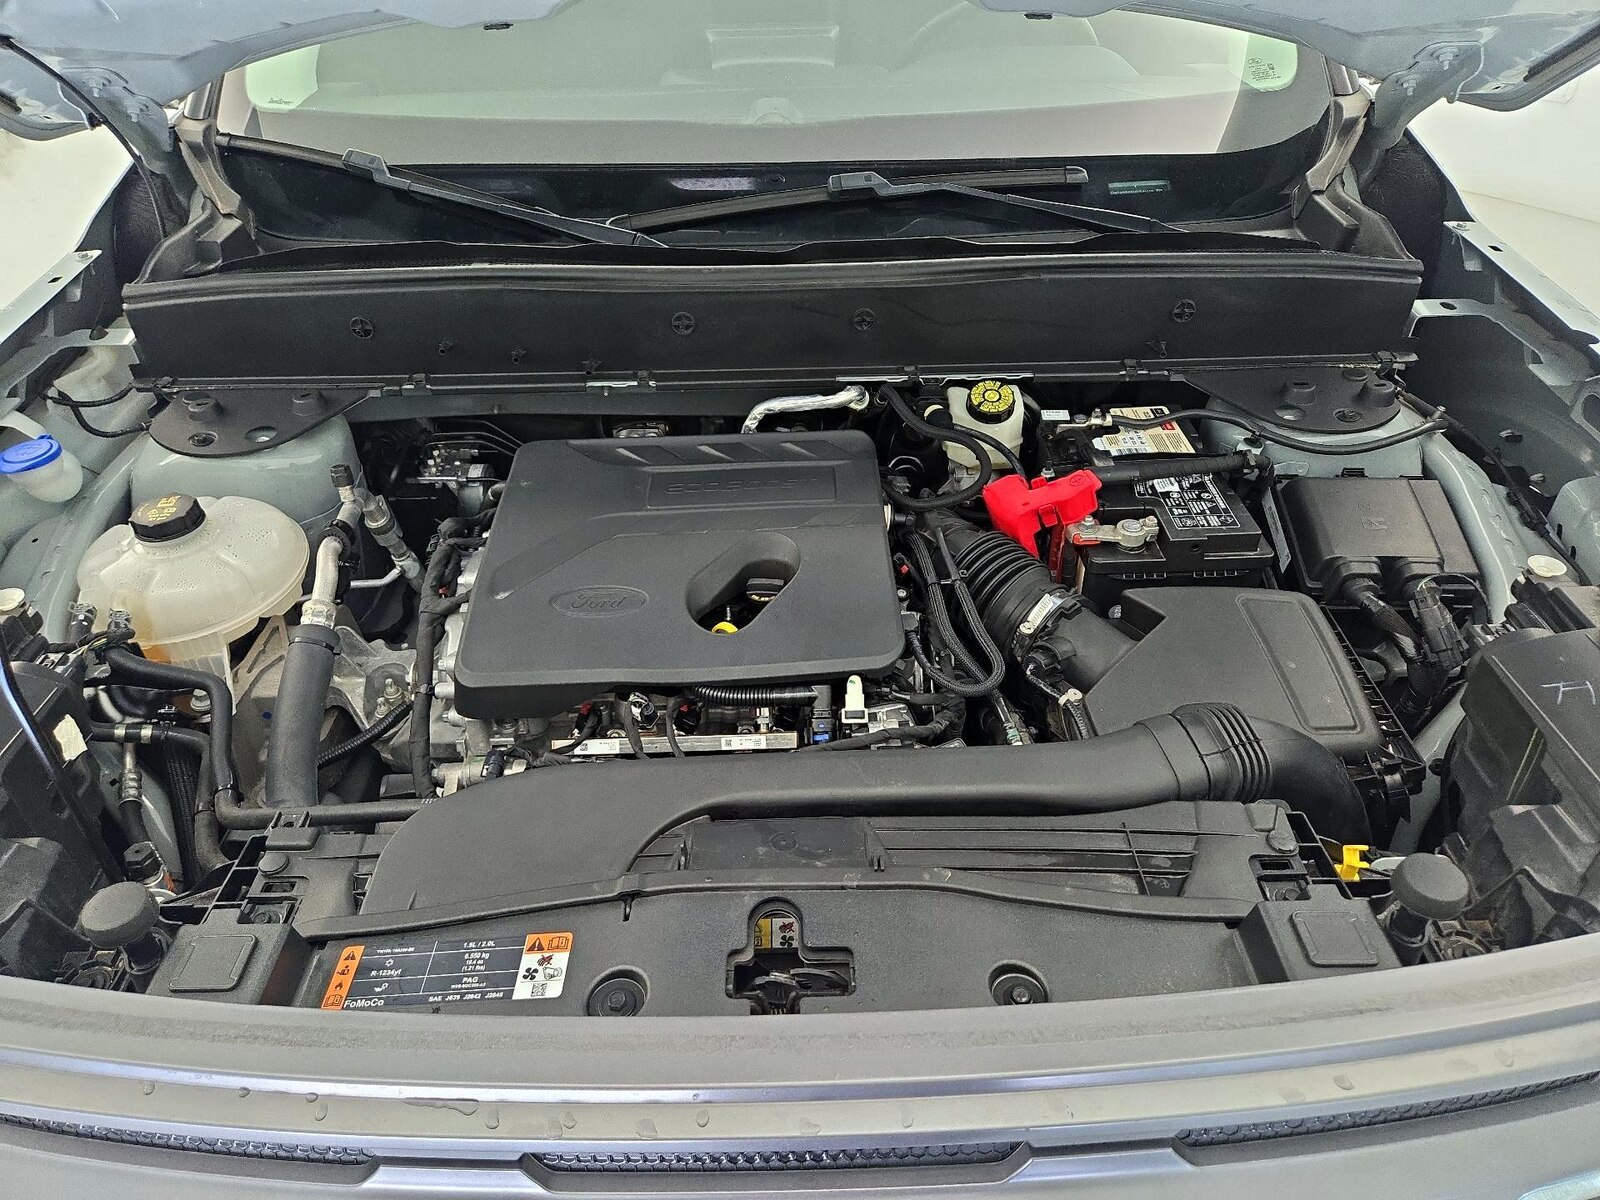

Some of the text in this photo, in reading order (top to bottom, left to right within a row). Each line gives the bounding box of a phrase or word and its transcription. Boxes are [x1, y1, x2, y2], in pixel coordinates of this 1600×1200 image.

[370, 968, 403, 977] R-1234yf
[462, 976, 479, 984] PAG
[343, 998, 385, 1008] FoMoCo
